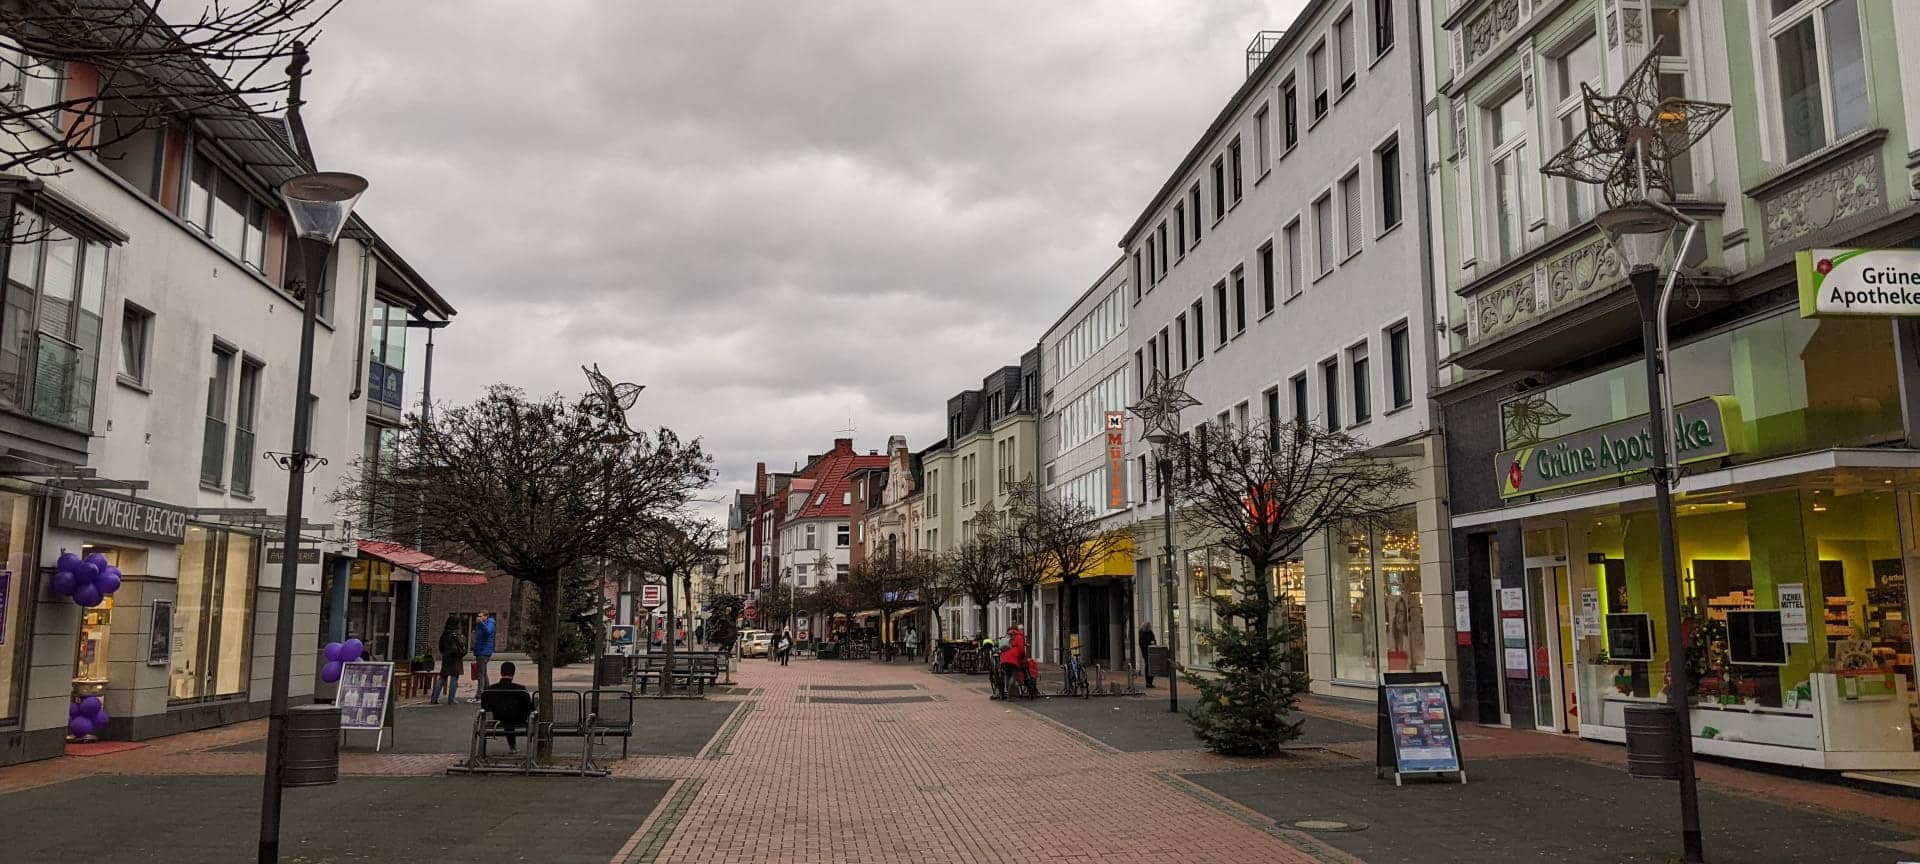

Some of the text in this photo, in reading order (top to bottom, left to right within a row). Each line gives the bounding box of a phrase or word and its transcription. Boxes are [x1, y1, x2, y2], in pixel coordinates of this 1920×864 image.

[1862, 266, 1920, 285] Grüne
[1830, 286, 1920, 308] Apotheke
[1537, 412, 1713, 481] Grüne Apotke
[144, 506, 186, 538] BECKER
